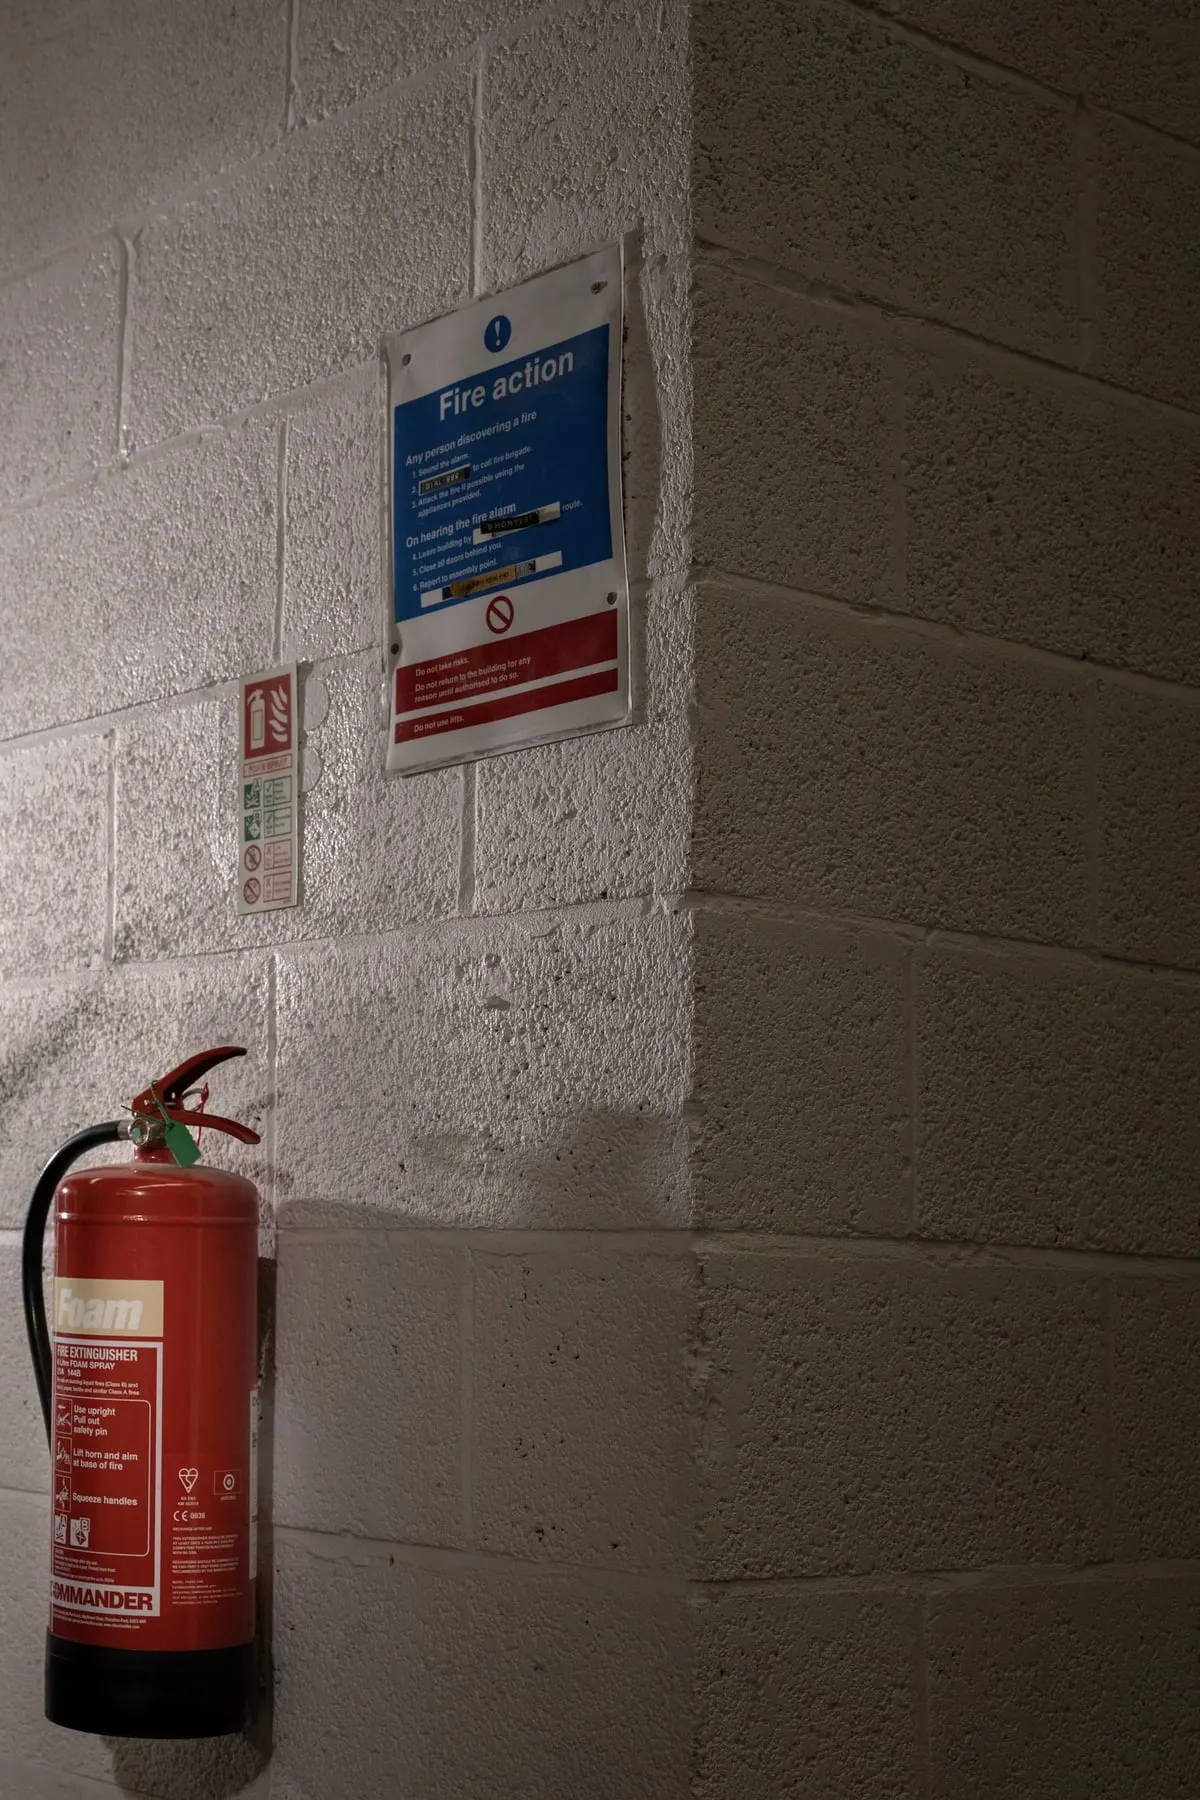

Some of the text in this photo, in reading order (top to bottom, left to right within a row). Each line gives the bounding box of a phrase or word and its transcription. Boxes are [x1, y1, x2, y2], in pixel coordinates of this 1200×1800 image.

[440, 351, 574, 421] Fire action
[406, 411, 537, 467] Any person discovering a fire
[412, 471, 418, 479] 1.
[418, 462, 440, 477] Sound
[440, 459, 450, 469] the
[472, 464, 480, 472] to
[480, 457, 492, 469] call
[493, 455, 504, 464] fire
[418, 493, 437, 506] Attack
[439, 490, 449, 500] the
[450, 486, 460, 495] fire
[461, 482, 466, 491] if
[467, 474, 493, 491] possible
[494, 468, 513, 480] using
[514, 463, 525, 473] the
[417, 489, 482, 519] appliances provided.
[406, 503, 516, 548] On hearing the fire alarm
[418, 548, 436, 560] Leave
[437, 538, 463, 553] building
[463, 535, 473, 545] by
[562, 500, 583, 512] route.
[418, 563, 437, 575] Close
[437, 558, 445, 568] all
[445, 553, 464, 566] doors
[464, 546, 488, 559] behind
[489, 542, 503, 553] you.
[419, 576, 441, 590] Report
[441, 575, 448, 583] to
[448, 564, 478, 581] assembly
[479, 557, 499, 572] point.
[415, 656, 470, 677] Do not take risks.
[415, 656, 531, 692] Do not return to the building for any
[414, 671, 520, 703] reason until authorised to do so.
[414, 715, 465, 733] Do not use lifts.
[57, 1288, 143, 1330] Foam
[57, 1344, 138, 1362] FIRE EXTINGUISHER
[67, 1368, 81, 1378] 144B
[70, 1359, 88, 1369] FOAM
[89, 1361, 115, 1370] SPRAY
[73, 1414, 100, 1425] Pull out
[74, 1404, 116, 1418] Use upright
[74, 1426, 108, 1437] safety pin
[73, 1448, 138, 1461] Lift horn and aim
[72, 1459, 124, 1471] at base of fire
[72, 1492, 138, 1507] Squeeze handles
[81, 1519, 89, 1531] B
[51, 1581, 153, 1611] OMMANDER
